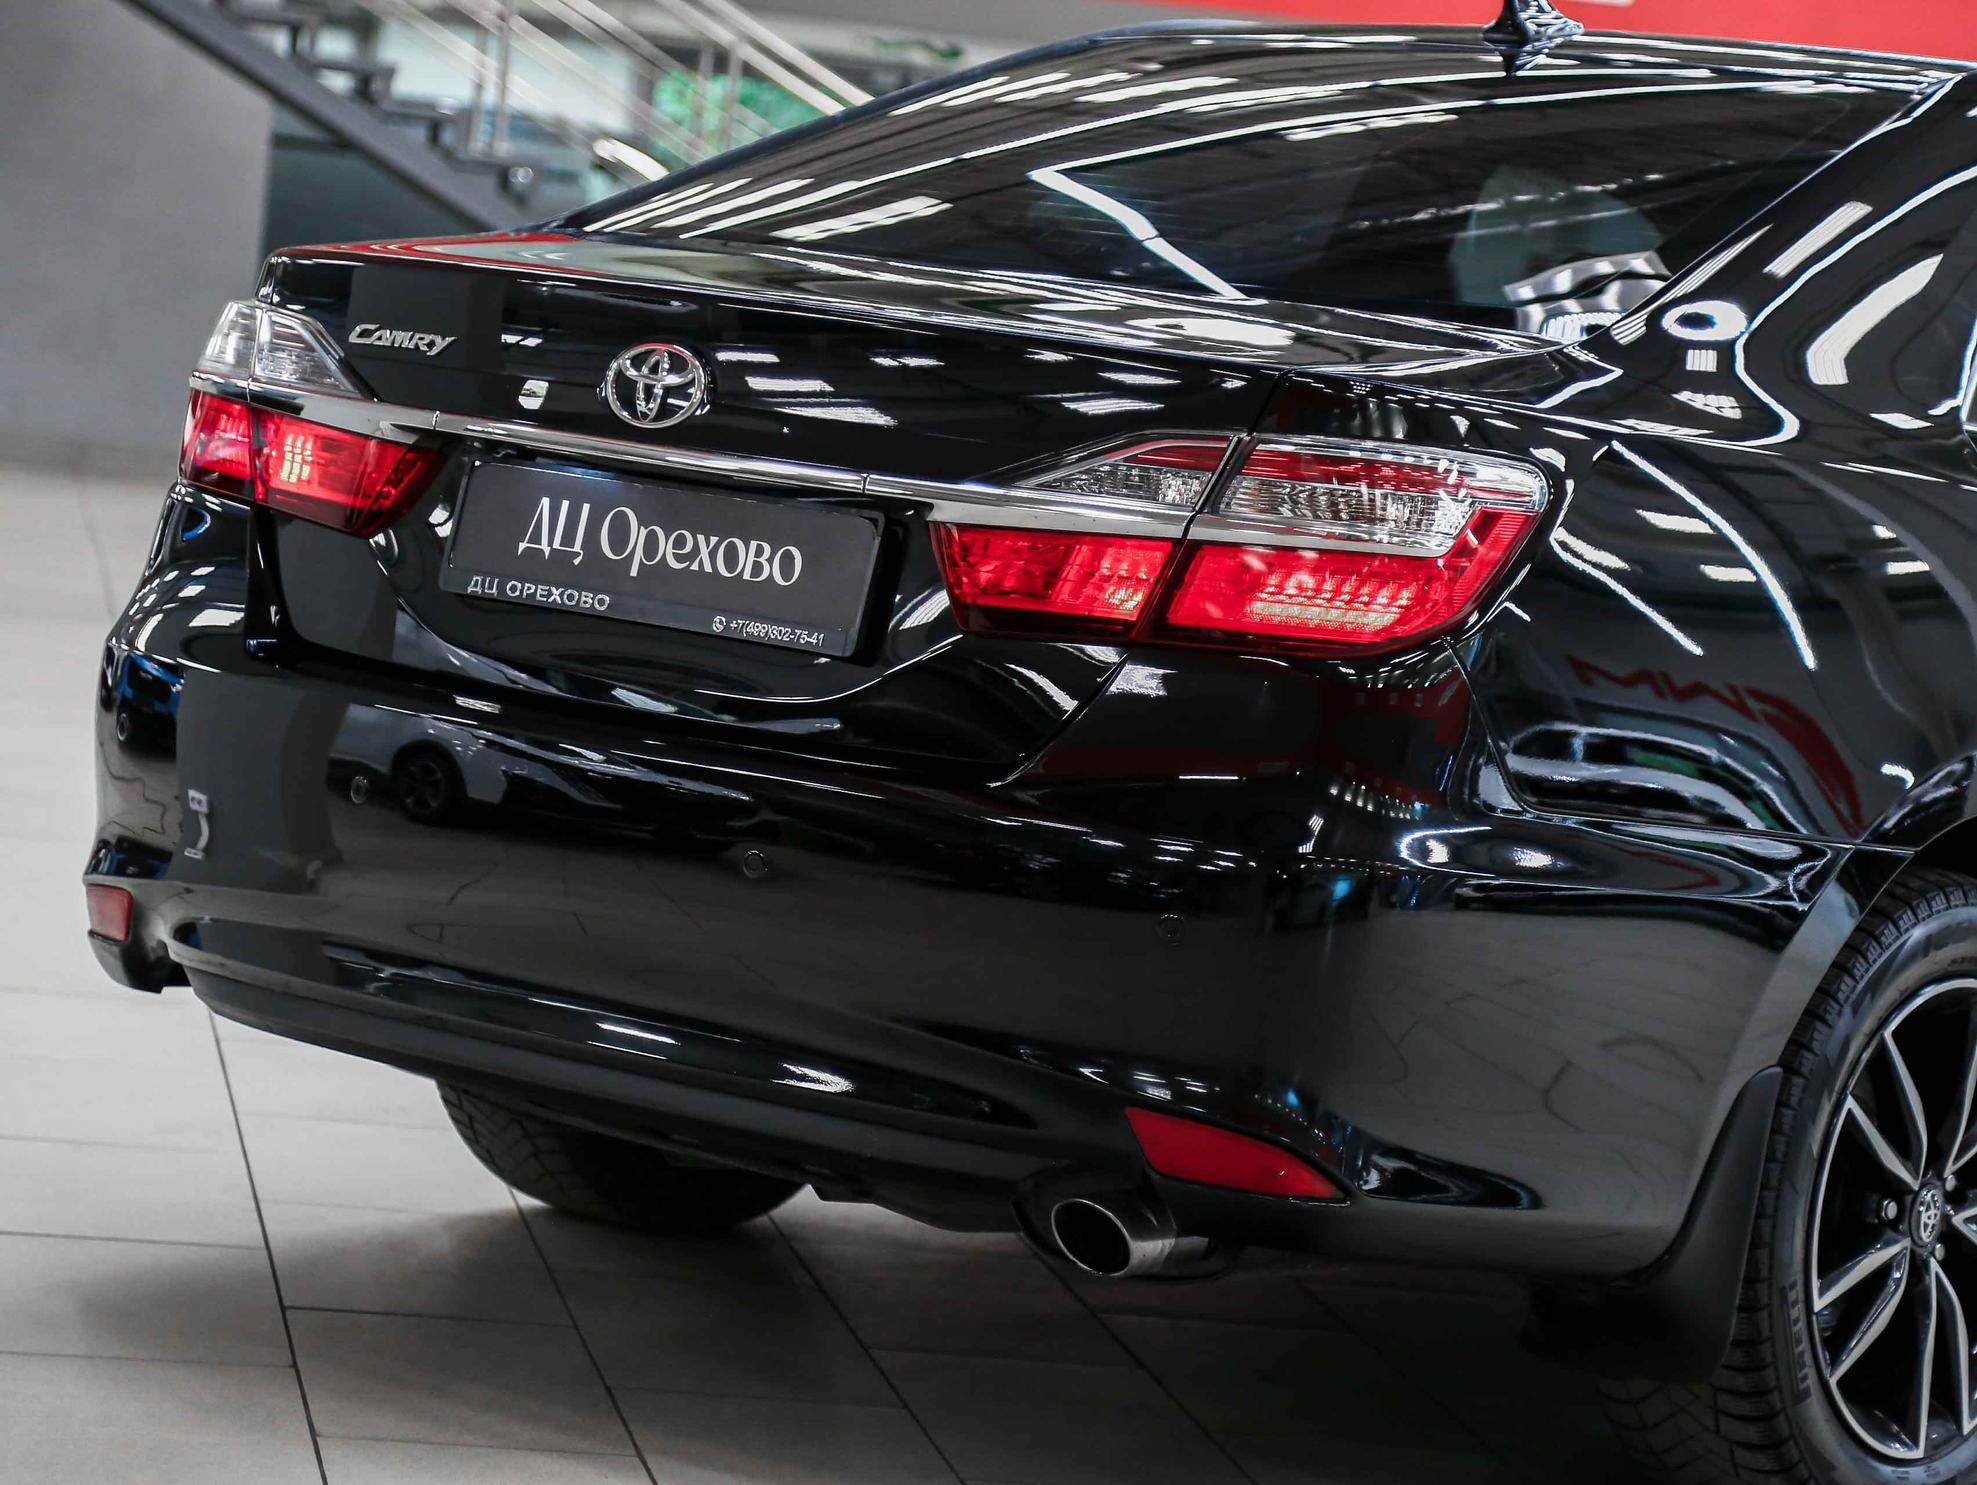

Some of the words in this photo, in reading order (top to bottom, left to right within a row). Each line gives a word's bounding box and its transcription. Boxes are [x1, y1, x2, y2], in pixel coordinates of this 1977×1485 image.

[348, 323, 457, 355] CAMRY
[518, 496, 590, 565] ДЦ
[601, 506, 803, 586] Орехово
[467, 576, 499, 597] ДЦ
[506, 580, 610, 611] ОРЕХОВО
